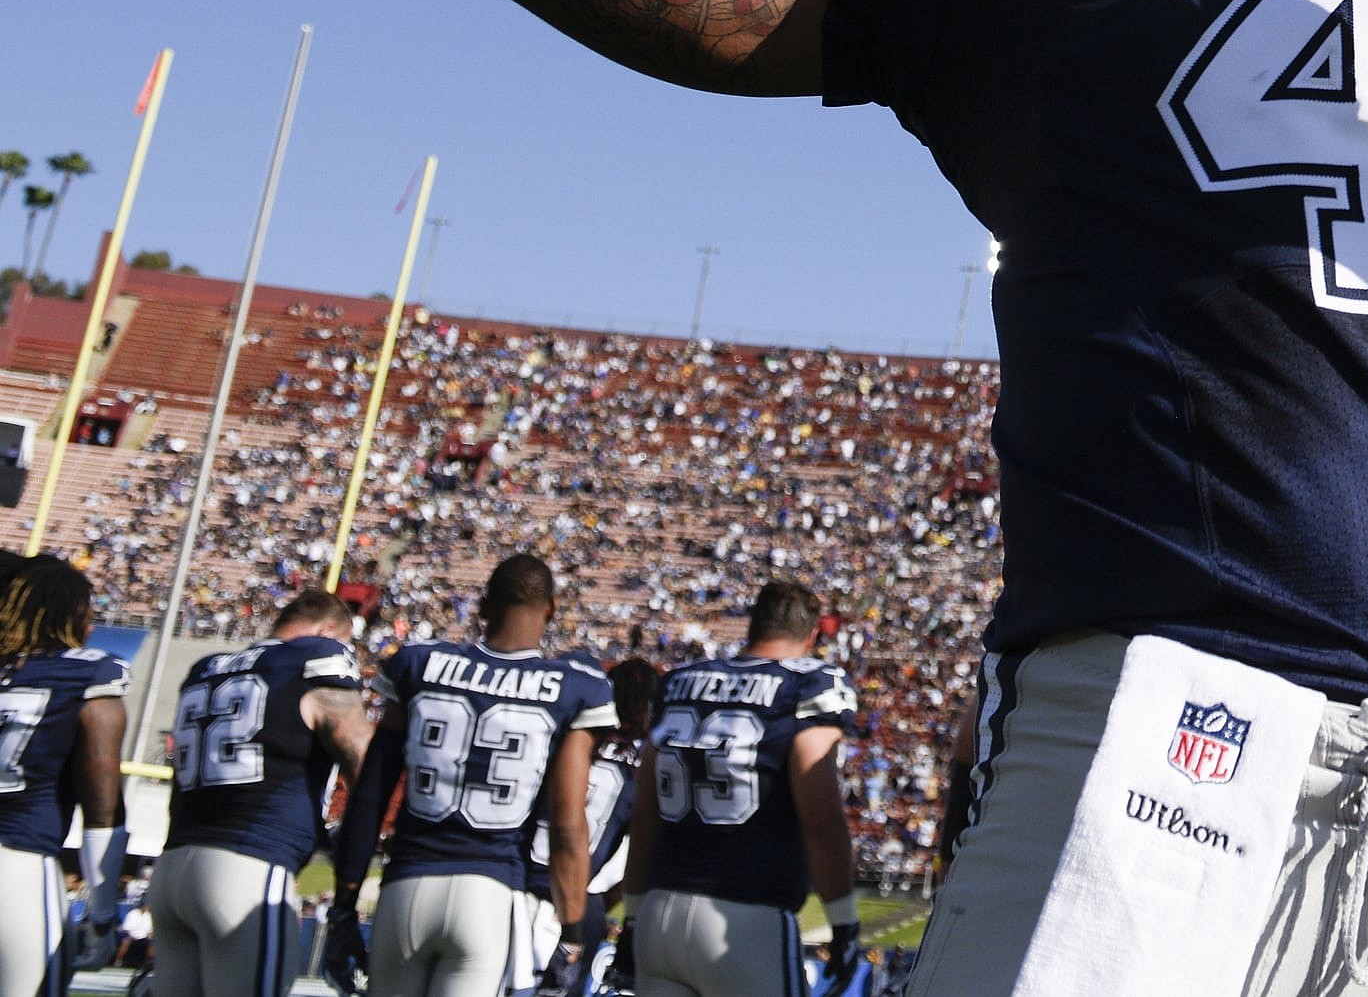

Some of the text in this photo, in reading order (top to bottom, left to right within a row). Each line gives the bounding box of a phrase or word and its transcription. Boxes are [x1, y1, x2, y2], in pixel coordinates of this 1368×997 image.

[421, 650, 564, 703] WILLIAMS
[174, 673, 270, 792] 62
[405, 691, 558, 830] 83
[651, 705, 766, 825] 63
[1171, 729, 1229, 780] NFL
[1126, 789, 1229, 853] Wilson
